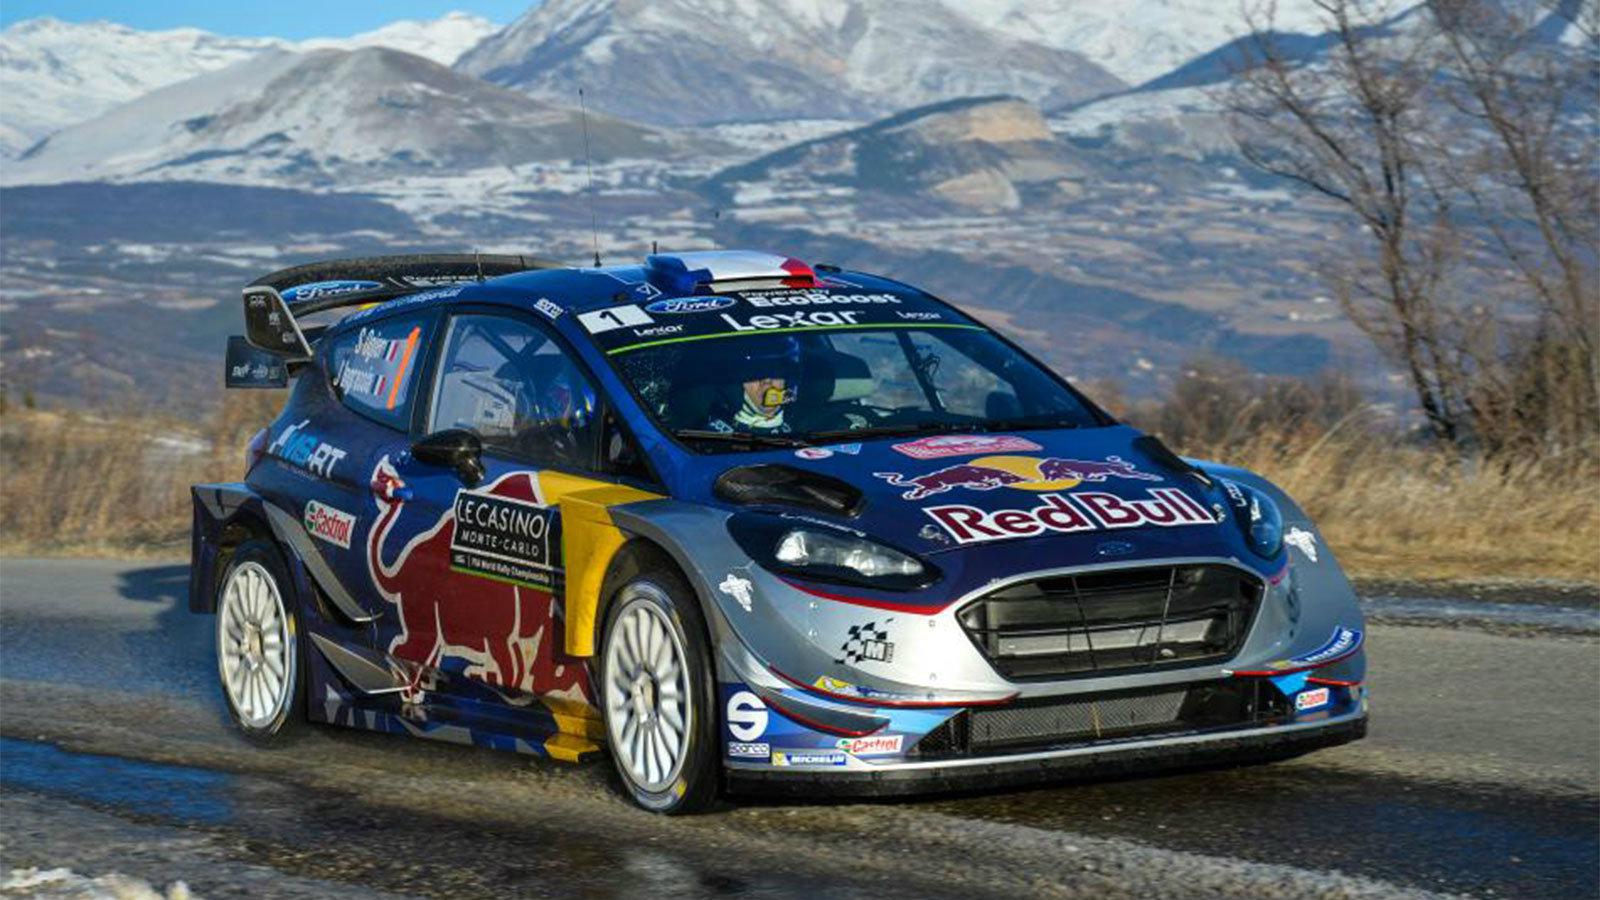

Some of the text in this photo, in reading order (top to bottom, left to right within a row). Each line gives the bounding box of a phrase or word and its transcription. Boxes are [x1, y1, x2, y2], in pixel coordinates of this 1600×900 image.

[664, 301, 721, 312] Ford
[750, 293, 903, 308] EcoBoost
[599, 310, 625, 326] 1
[719, 311, 858, 331] Lexar
[633, 324, 684, 337] Lexar
[457, 499, 545, 539] LE CASINO
[922, 494, 1097, 543] Red
[1069, 488, 1218, 528] Bull
[315, 507, 352, 544] Castrol
[852, 736, 899, 754] Castrol
[789, 753, 846, 764] MICHELIN
